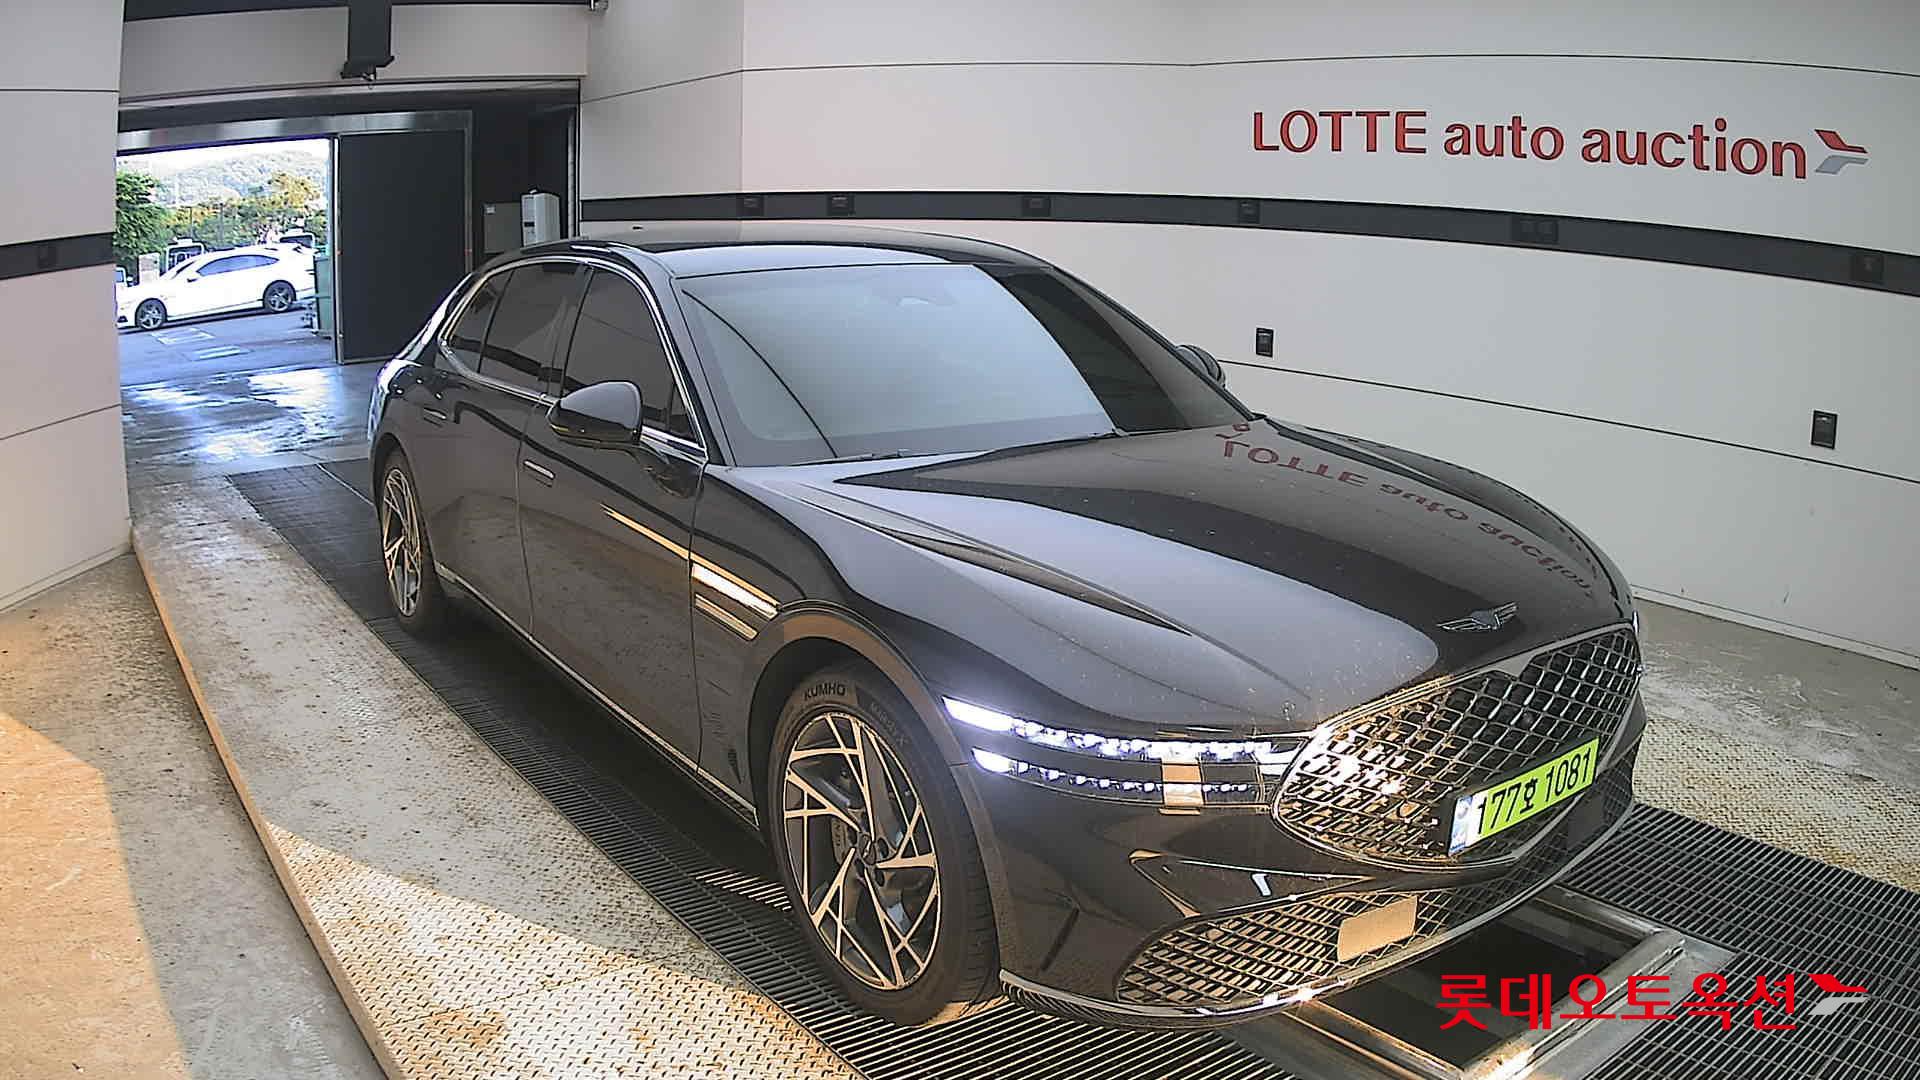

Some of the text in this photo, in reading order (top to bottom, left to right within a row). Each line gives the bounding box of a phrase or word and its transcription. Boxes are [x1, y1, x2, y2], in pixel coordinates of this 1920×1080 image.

[1253, 111, 1807, 180] LOTTE auto auction
[804, 682, 846, 700] KUMHO
[1478, 747, 1591, 834] 177호 1081
